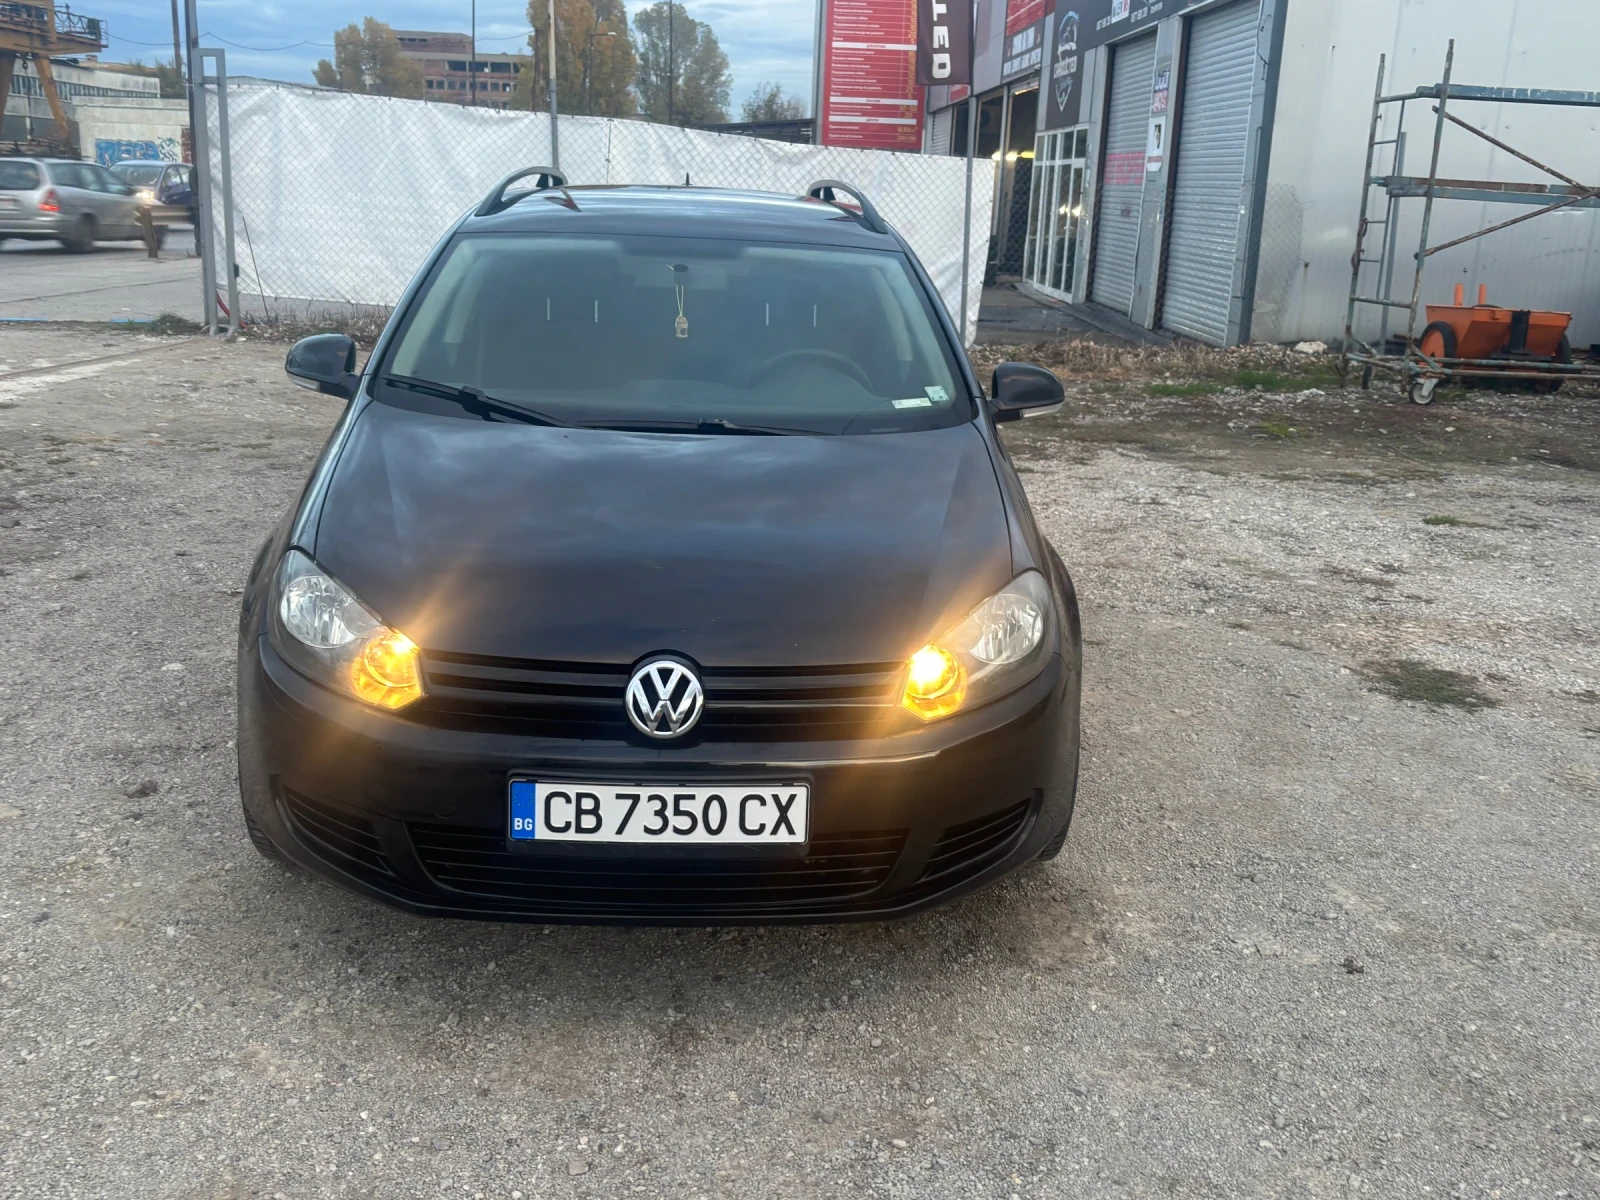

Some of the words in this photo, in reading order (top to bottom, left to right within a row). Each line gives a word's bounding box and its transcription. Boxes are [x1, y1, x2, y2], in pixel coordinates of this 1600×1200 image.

[513, 817, 533, 831] BG
[544, 791, 603, 834] CB
[615, 793, 728, 836] 7350
[738, 793, 798, 836] CX
